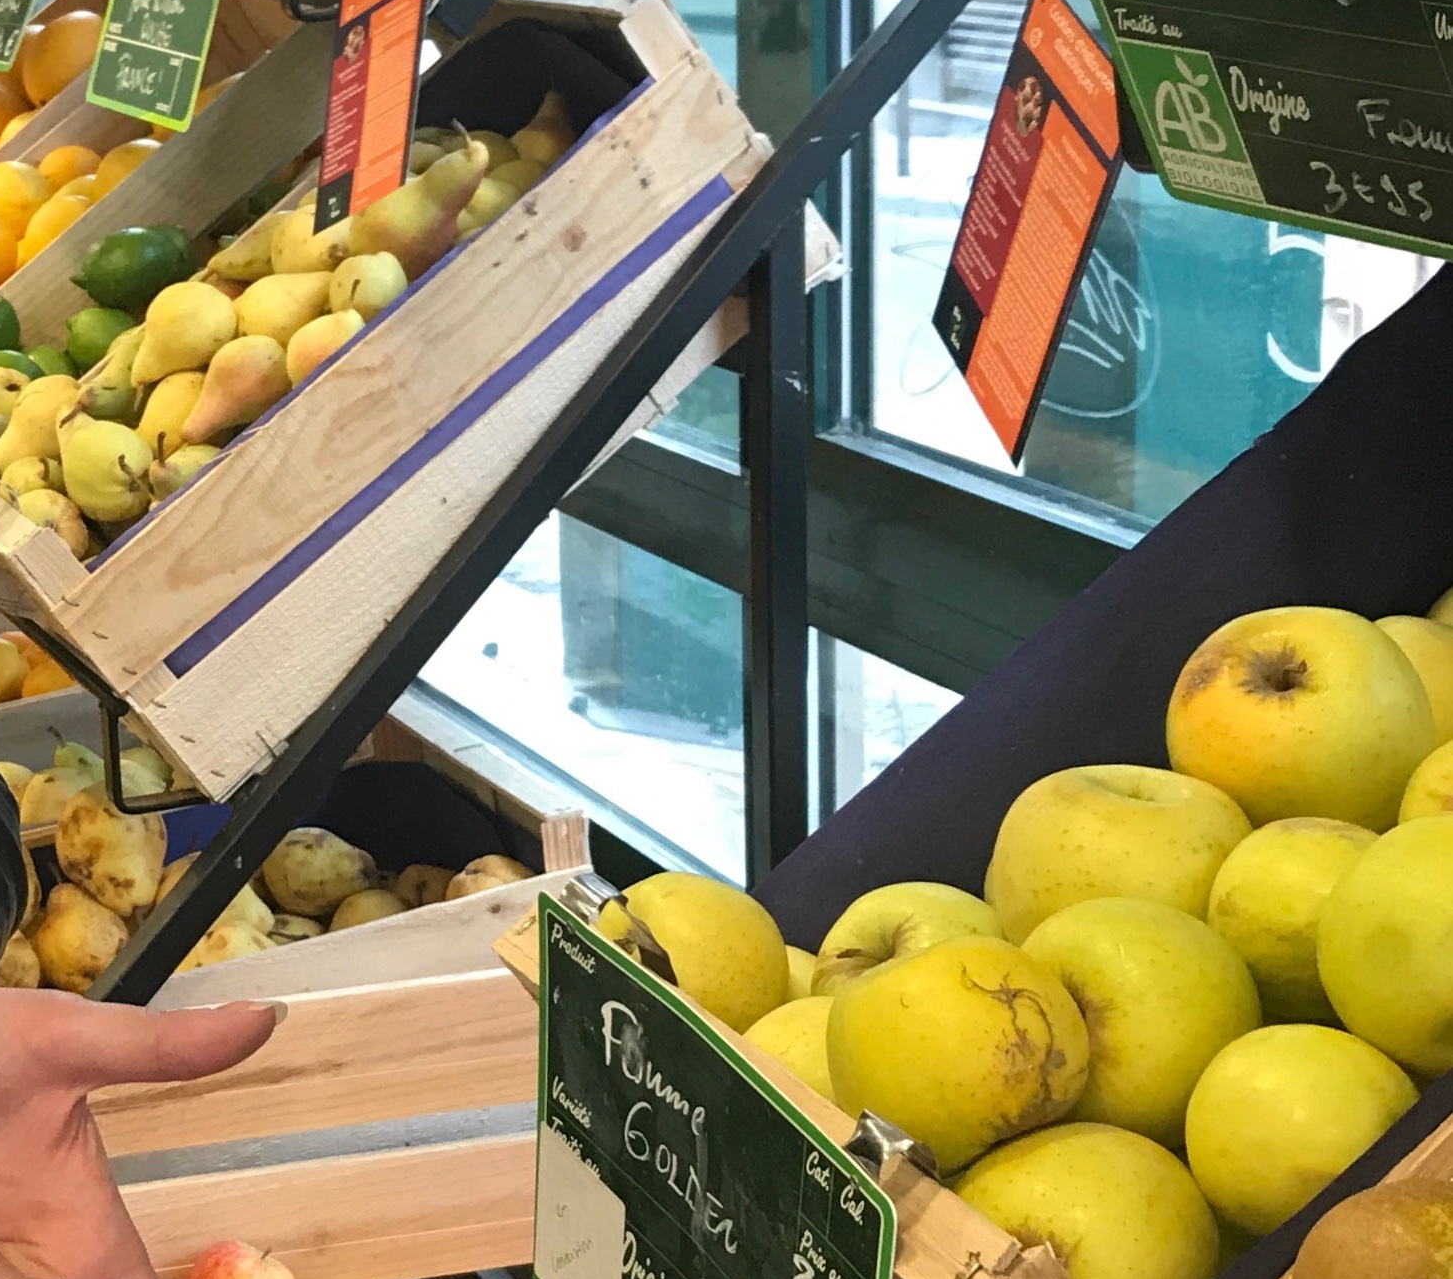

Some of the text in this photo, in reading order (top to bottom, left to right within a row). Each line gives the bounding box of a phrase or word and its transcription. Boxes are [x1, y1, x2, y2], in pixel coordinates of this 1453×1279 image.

[1113, 8, 1183, 39] Traité au
[1229, 65, 1311, 136] Origine
[1162, 151, 1258, 182] AGRICULTURE
[1167, 167, 1262, 199] BIOLOGIQUE
[551, 922, 598, 974] Produit
[552, 1075, 592, 1130] Variété
[805, 1150, 830, 1191] Cat.
[839, 1184, 864, 1225] Cal.
[800, 1229, 827, 1273] Prix
